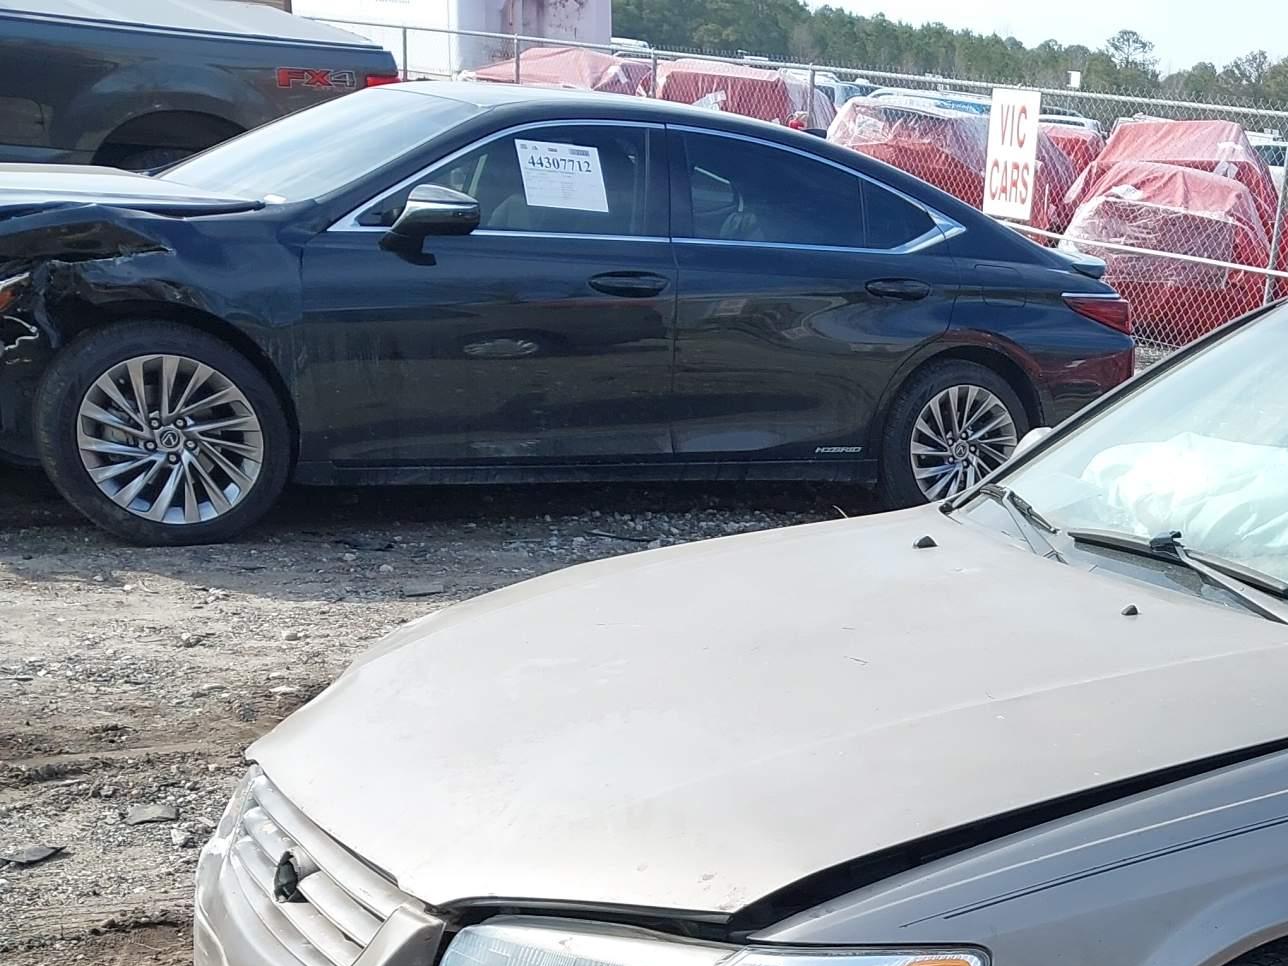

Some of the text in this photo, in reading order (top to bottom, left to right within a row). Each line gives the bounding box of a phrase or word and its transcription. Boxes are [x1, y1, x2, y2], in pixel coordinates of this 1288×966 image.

[276, 66, 357, 88] FX4
[1001, 104, 1028, 149] VIC
[528, 154, 592, 173] 44307712
[989, 158, 1030, 205] CARS
